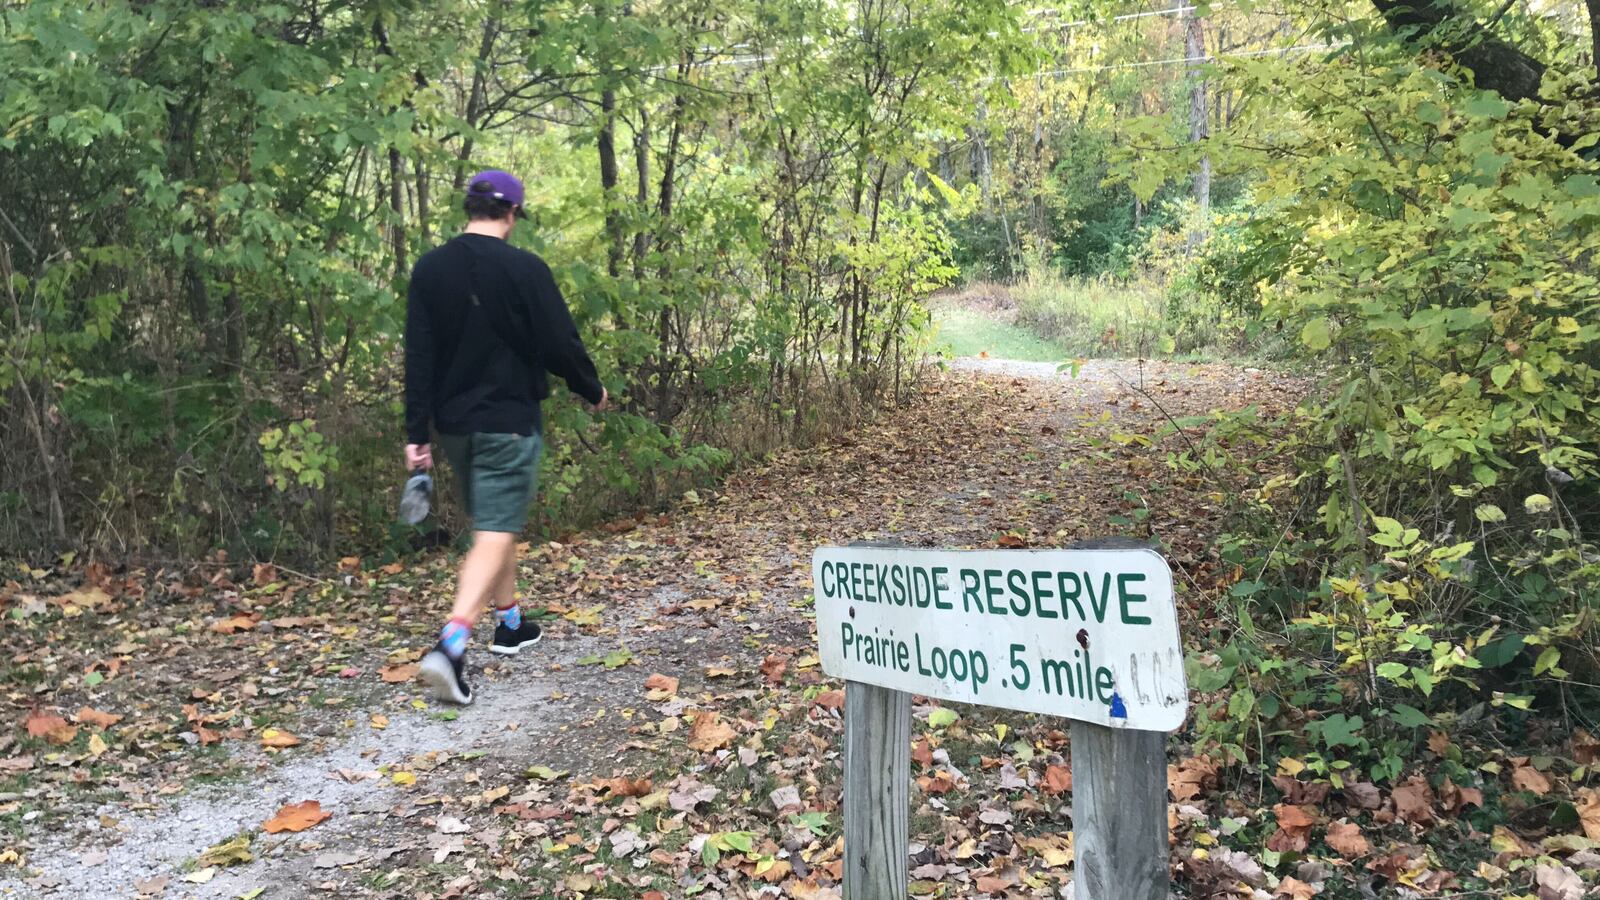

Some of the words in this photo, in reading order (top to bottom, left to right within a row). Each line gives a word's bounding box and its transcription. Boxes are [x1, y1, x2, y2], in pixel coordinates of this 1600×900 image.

[821, 560, 953, 610] CREEKSIDE
[959, 568, 1152, 625] RESERVE
[841, 622, 910, 672] Prairie
[914, 632, 989, 695] Loop
[1002, 643, 1031, 691] .5
[1040, 649, 1114, 706] mile
